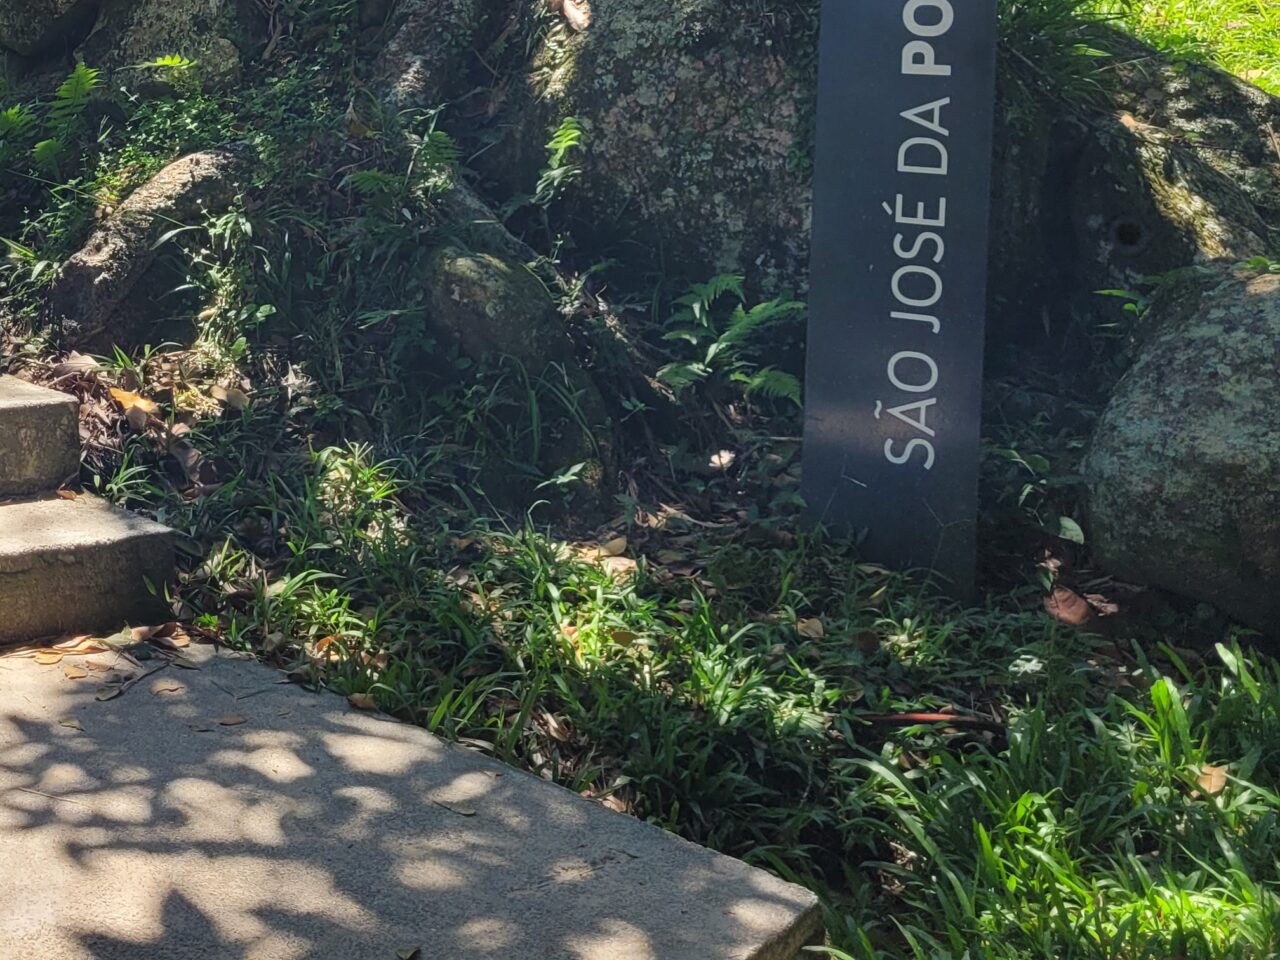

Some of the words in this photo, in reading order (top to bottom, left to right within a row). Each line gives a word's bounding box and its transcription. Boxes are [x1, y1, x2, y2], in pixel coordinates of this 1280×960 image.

[897, 96, 951, 176] DA
[881, 193, 946, 334] JOSÉ
[874, 350, 939, 470] SÃO
